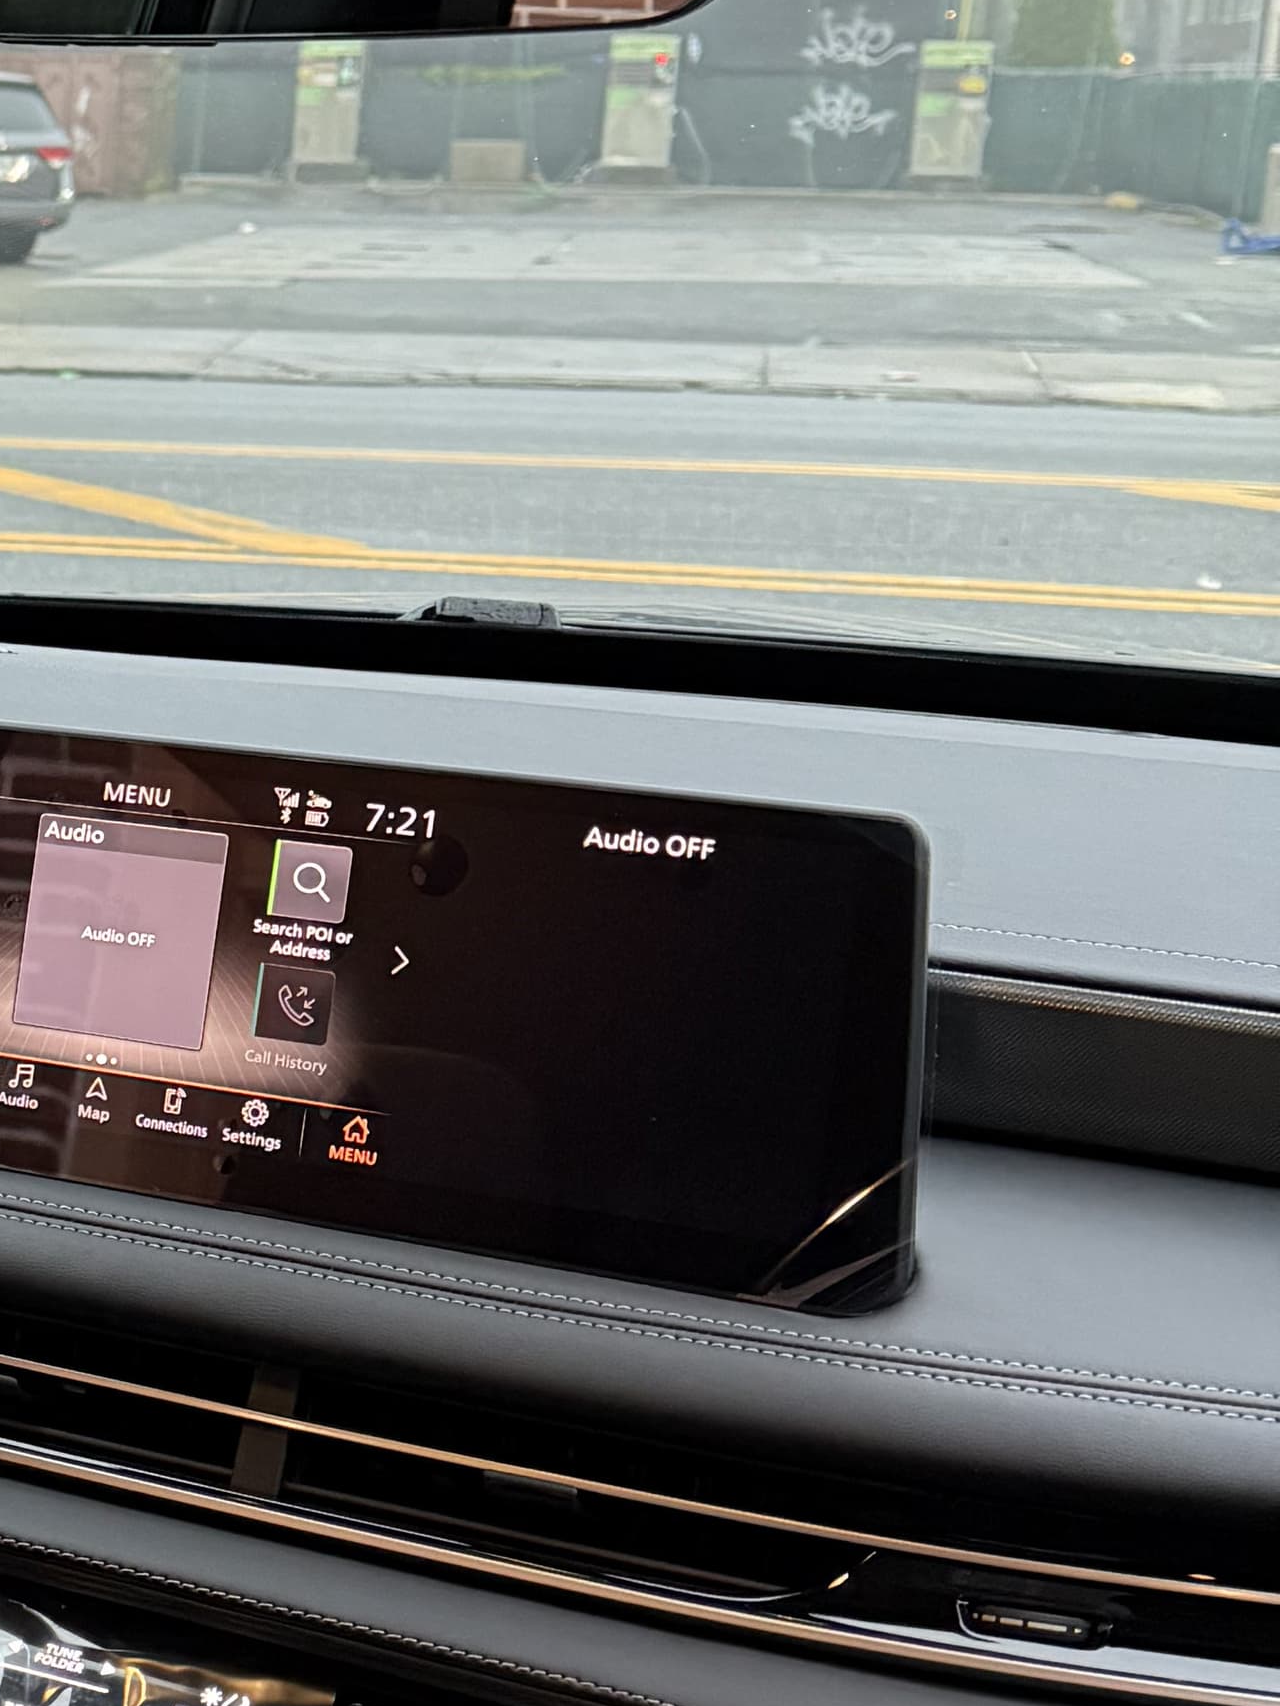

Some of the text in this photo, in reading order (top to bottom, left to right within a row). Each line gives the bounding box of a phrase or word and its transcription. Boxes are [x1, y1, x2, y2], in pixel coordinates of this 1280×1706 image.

[103, 782, 171, 808] MENU
[44, 820, 106, 845] Audio
[365, 802, 436, 839] 7:21
[583, 826, 717, 860] Audio OFF
[80, 925, 156, 948] Audio OFF
[253, 918, 354, 945] Search POI or
[269, 939, 332, 961] Address
[244, 1048, 328, 1076] Call History
[78, 1103, 111, 1124] Map
[135, 1113, 208, 1138] Connections
[222, 1127, 282, 1152] Settings
[328, 1144, 378, 1167] MENU
[34, 1651, 86, 1675] FOLDER
[46, 1642, 83, 1663] TUNE
